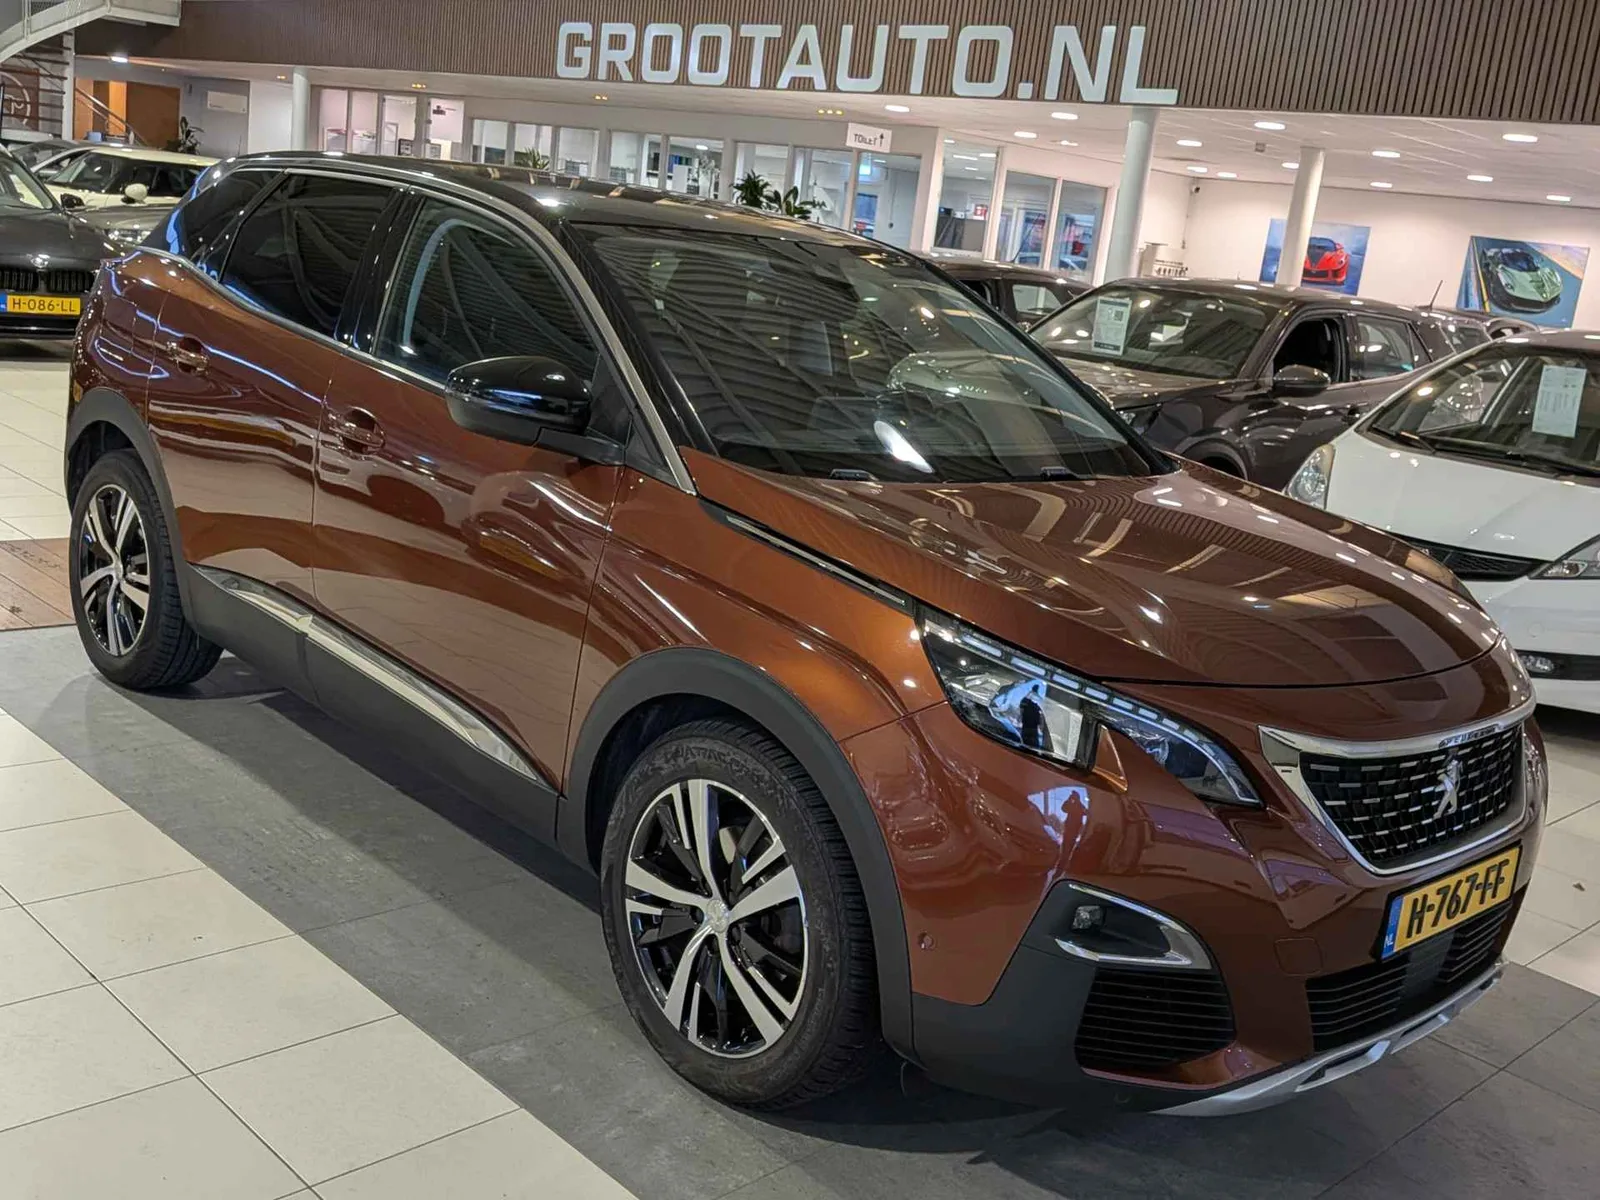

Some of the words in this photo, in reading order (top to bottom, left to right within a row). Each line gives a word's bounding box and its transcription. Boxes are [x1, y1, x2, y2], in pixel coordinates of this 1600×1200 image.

[557, 22, 1178, 105] GROOTAUTO.NL
[12, 298, 76, 312] H-086-LL
[1406, 858, 1510, 939] H-767-FF
